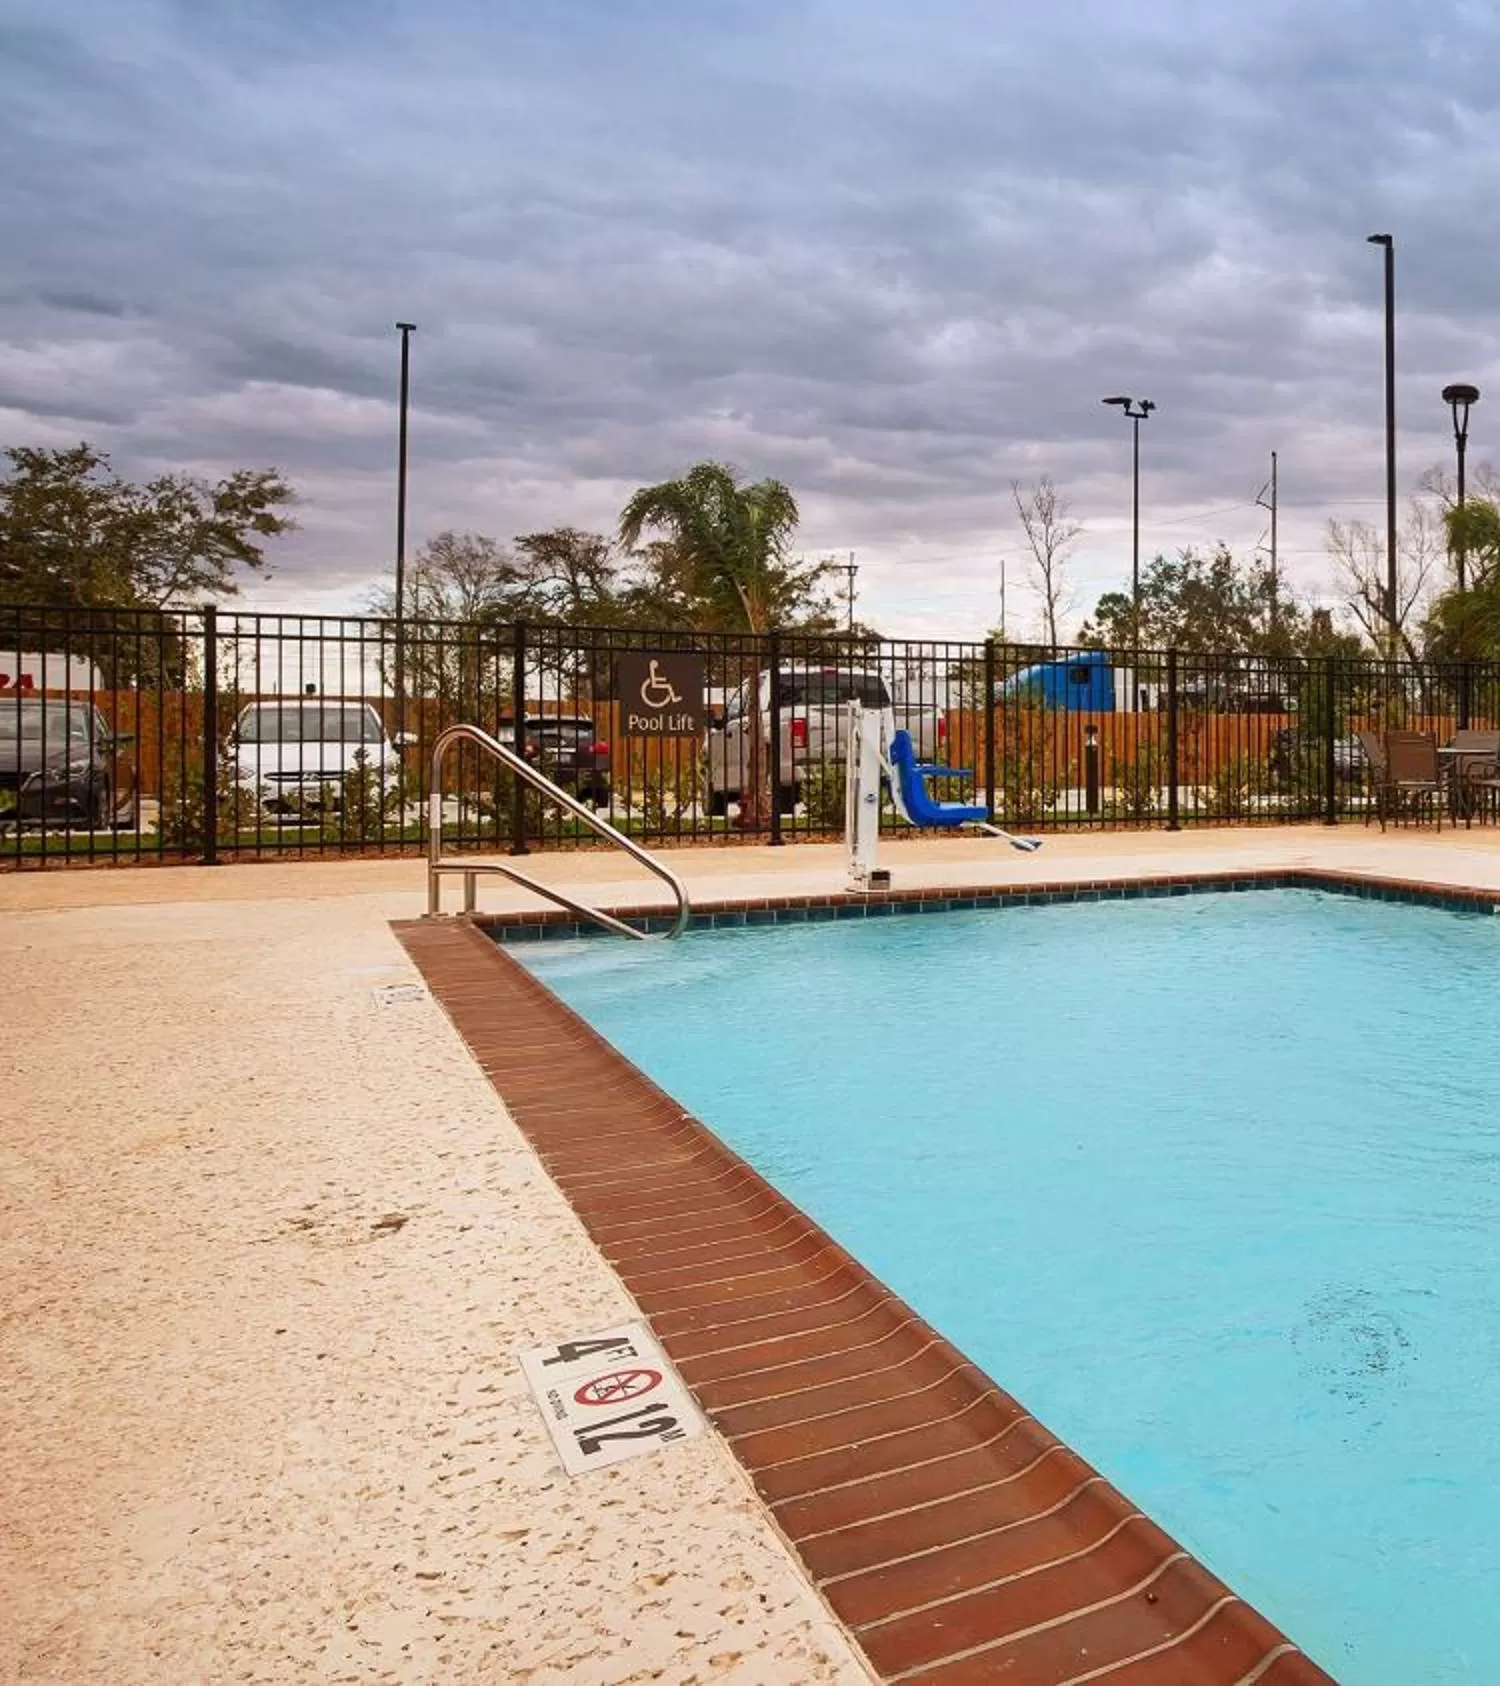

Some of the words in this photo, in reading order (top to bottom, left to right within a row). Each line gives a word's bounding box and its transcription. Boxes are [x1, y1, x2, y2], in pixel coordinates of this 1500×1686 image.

[628, 714, 663, 731] Pool
[668, 713, 695, 731] Lift
[542, 1338, 629, 1366] 4
[604, 1345, 639, 1363] FT
